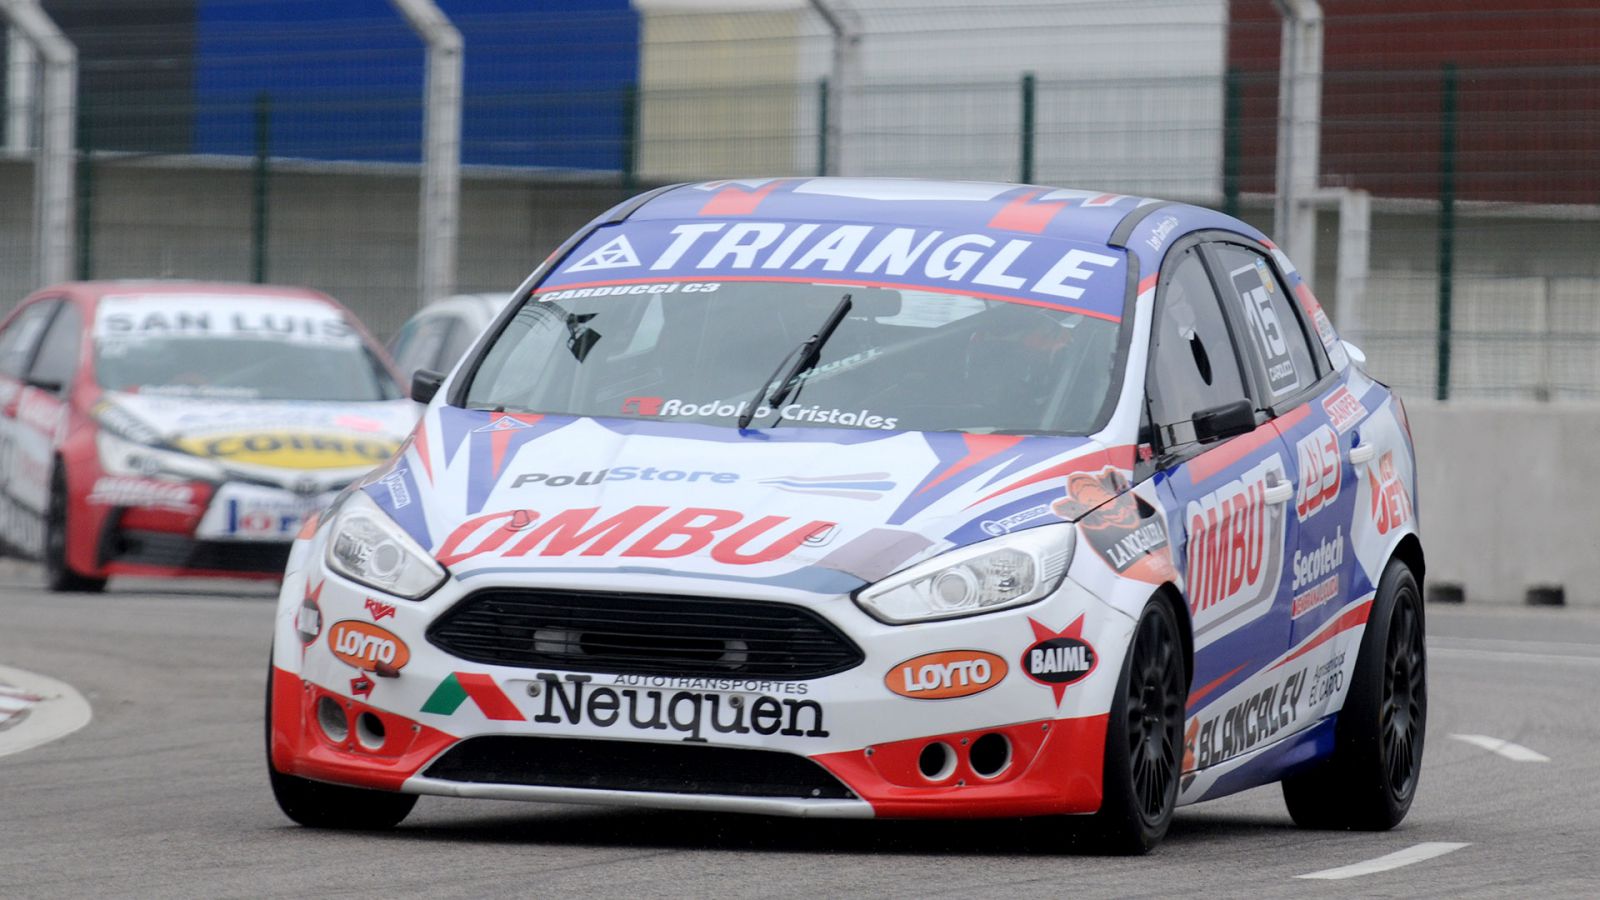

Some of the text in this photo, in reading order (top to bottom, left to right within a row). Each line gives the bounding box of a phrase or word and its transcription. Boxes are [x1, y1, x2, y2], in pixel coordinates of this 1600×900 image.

[650, 222, 1119, 299] TRIANGLE
[538, 282, 721, 302] CARDUCCI C3
[106, 312, 352, 338] SAN LUIS
[1242, 286, 1287, 360] 15
[659, 399, 898, 430] Rodolo Cristales
[435, 504, 838, 567] OMBU
[1187, 480, 1265, 617] OMBU
[1292, 525, 1344, 591] Secotech
[335, 627, 397, 665] LOYTO
[1031, 646, 1089, 674] BAIML
[614, 673, 809, 695] AUTOTRANSPORTES
[903, 658, 991, 692] LOYTO
[534, 672, 830, 743] Neuquen
[1199, 667, 1308, 769] BLANCALEY
